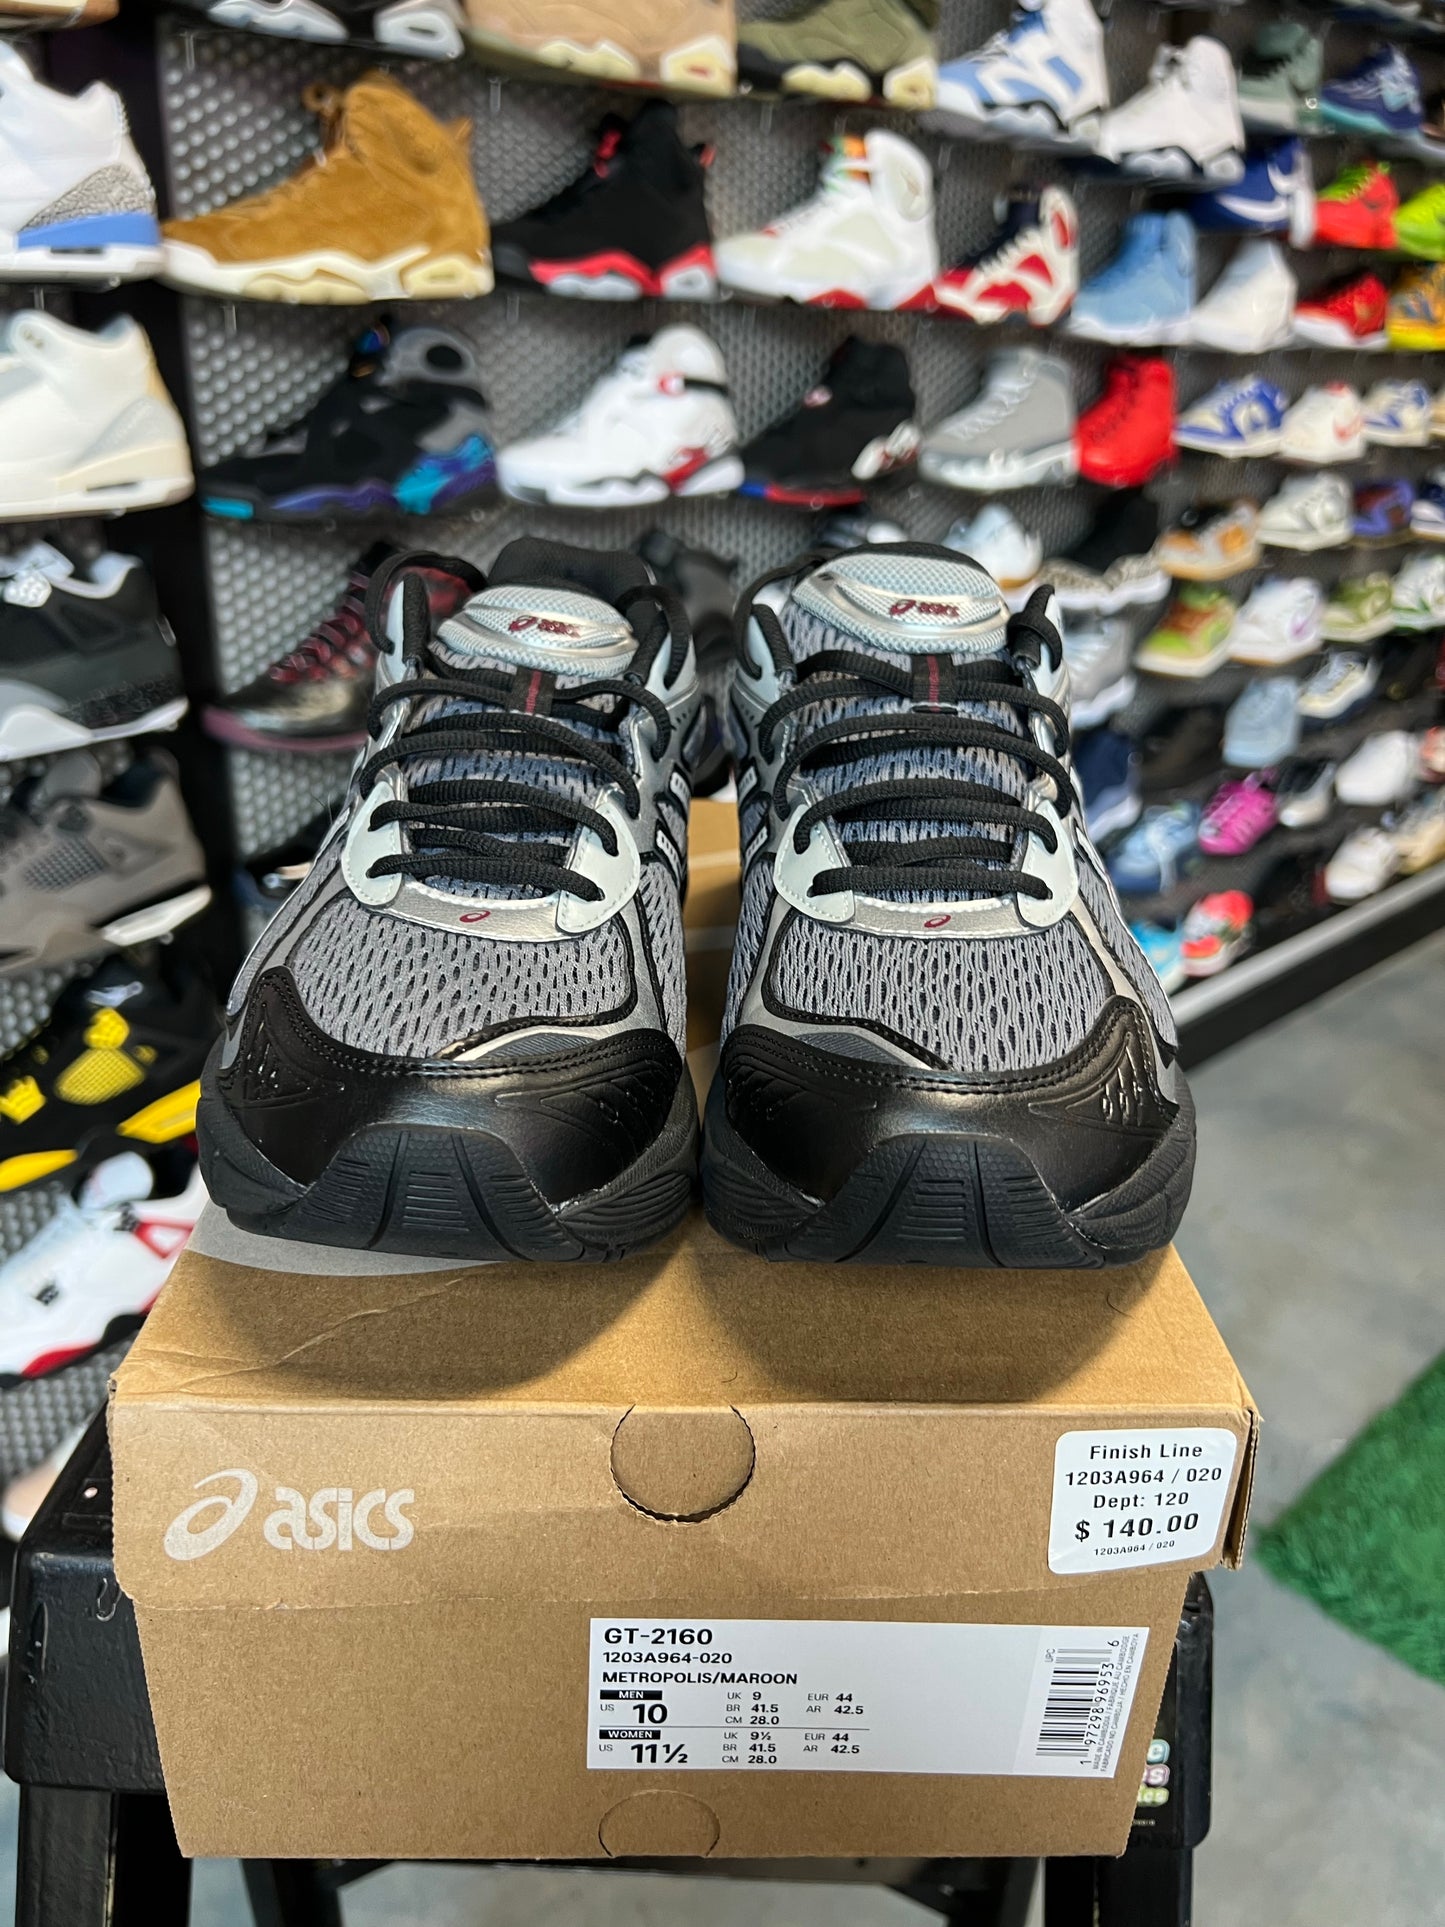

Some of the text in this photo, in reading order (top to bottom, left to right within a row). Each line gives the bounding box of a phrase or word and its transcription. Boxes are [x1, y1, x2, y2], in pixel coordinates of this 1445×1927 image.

[1090, 1443, 1203, 1460] Finish Line
[1065, 1467, 1222, 1486] 1203A964 / 020
[1093, 1492, 1189, 1511] Dept: 120
[263, 1486, 415, 1551] asics
[1074, 1512, 1199, 1543] $ 140.00
[1094, 1544, 1146, 1556] 1203A964
[1156, 1540, 1175, 1550] 020
[603, 1627, 713, 1645] GT-2160
[603, 1651, 733, 1664] 1203A964-020
[602, 1671, 798, 1685] METROPOLIS/MAROON
[618, 1690, 644, 1699] MEN
[727, 1691, 762, 1701] UK 9
[807, 1693, 853, 1702] EUR 44
[726, 1703, 779, 1713] BR 41.5
[806, 1705, 864, 1715] AR 42.5
[600, 1703, 668, 1724] US 10
[725, 1715, 780, 1725] CM 28.0
[608, 1730, 653, 1739] WOMEN
[724, 1731, 738, 1740] UK
[804, 1733, 849, 1742] EUR 44
[599, 1744, 613, 1752] US
[722, 1743, 776, 1753] BR 41.5
[803, 1744, 860, 1754] AR 42.5
[721, 1755, 777, 1764] CM 28.0
[1092, 1753, 1103, 1770] MADE
